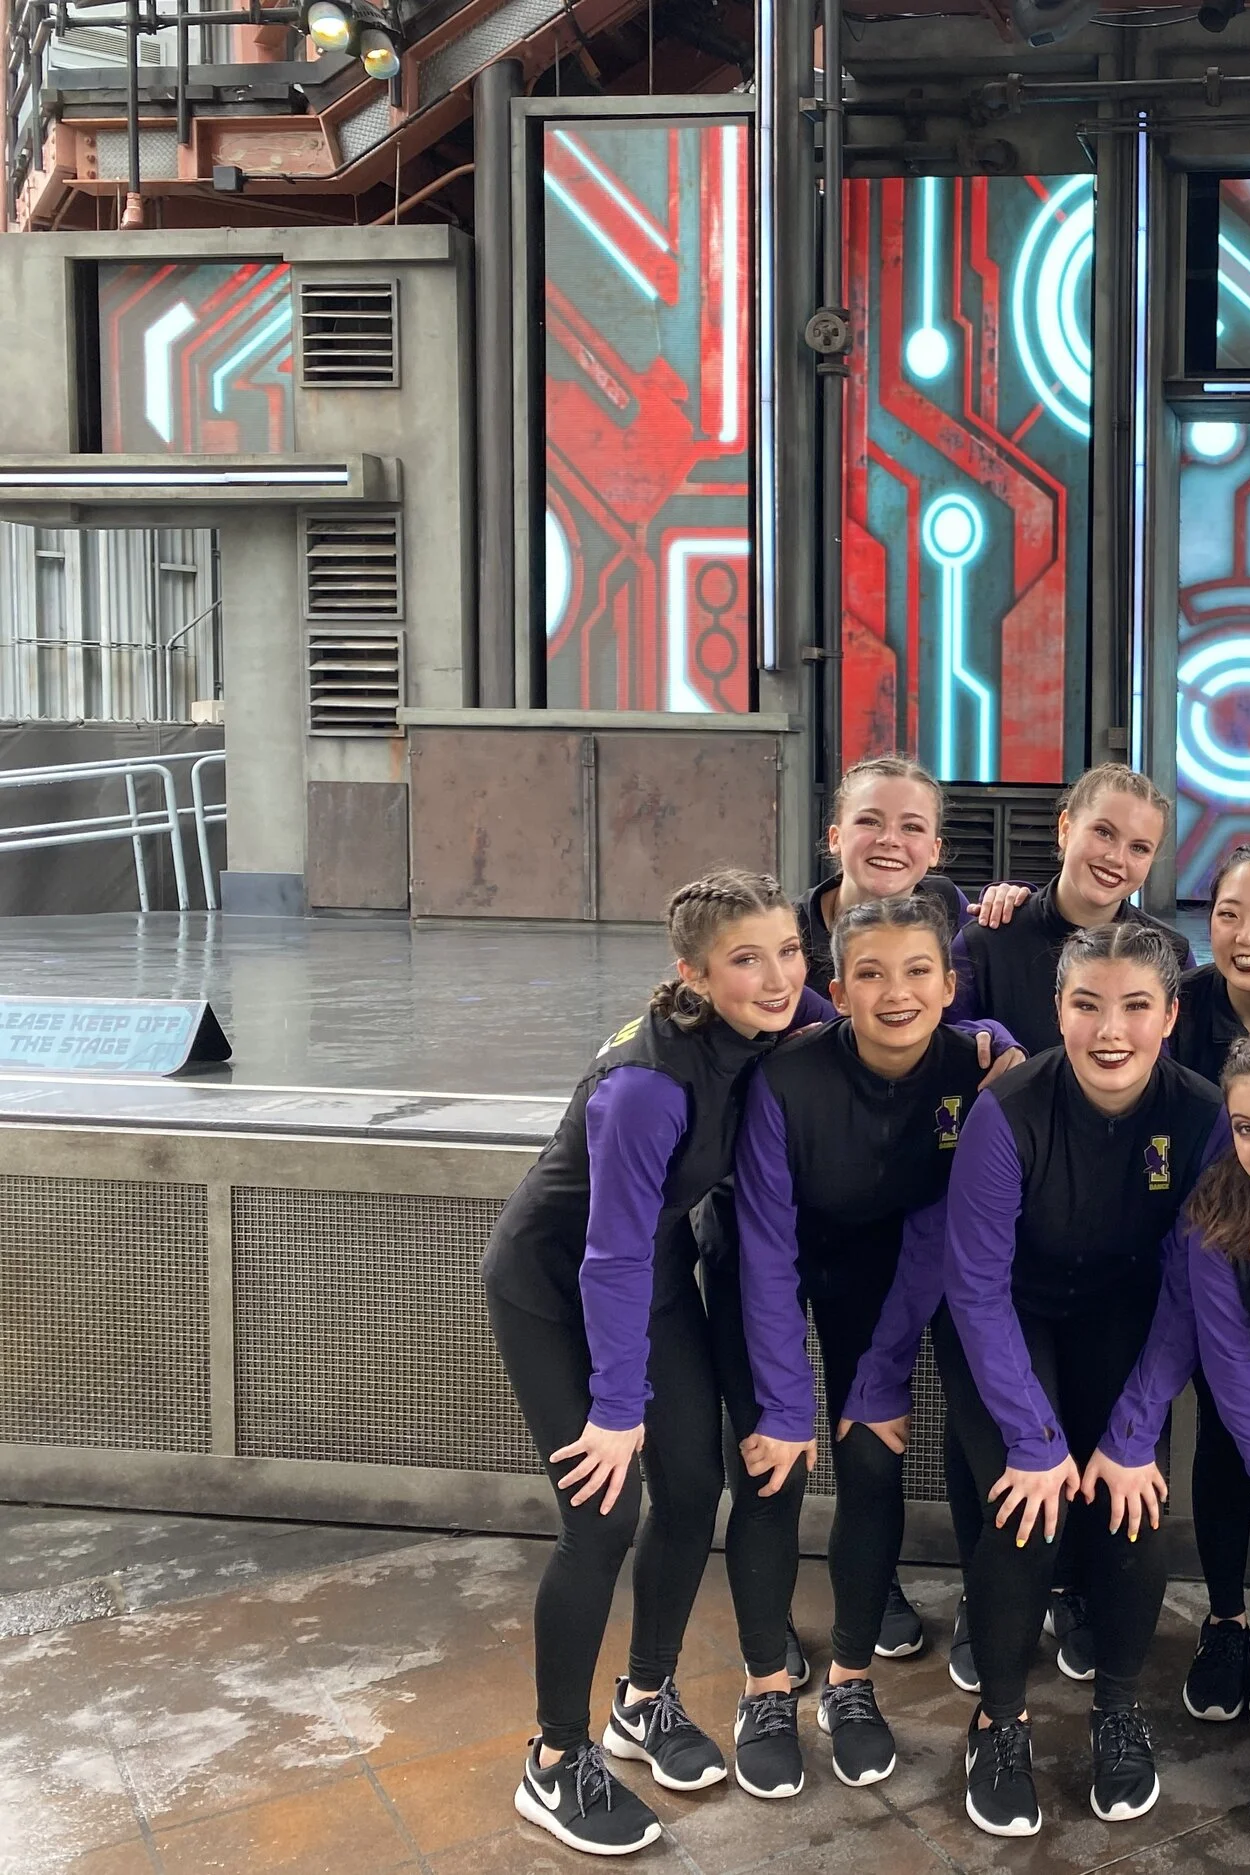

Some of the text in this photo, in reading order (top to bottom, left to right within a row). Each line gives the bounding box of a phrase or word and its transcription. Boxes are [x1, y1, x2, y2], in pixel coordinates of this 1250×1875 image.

[69, 1014, 131, 1032] KEEP
[135, 1016, 182, 1033] OFF
[10, 1035, 131, 1055] THE STAGE
